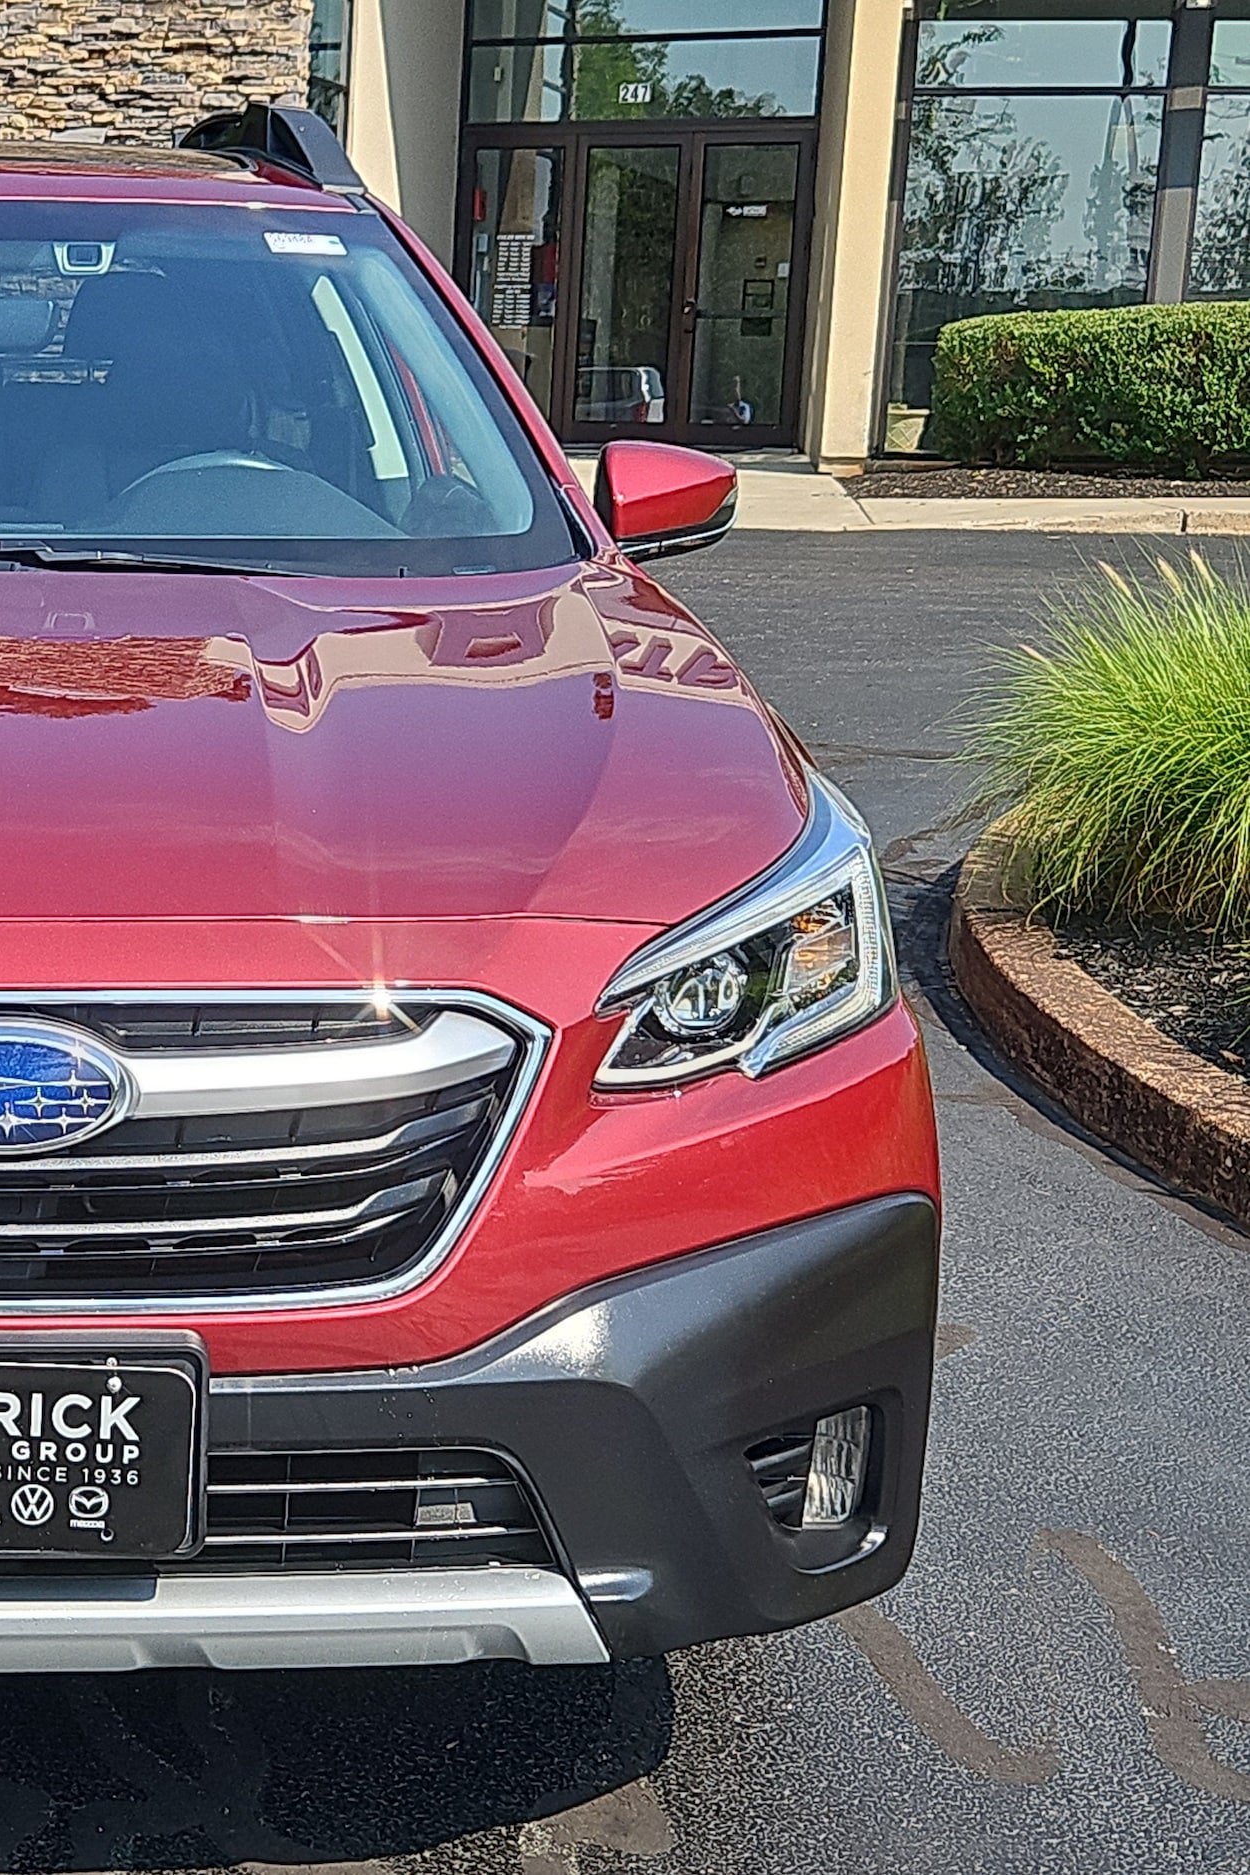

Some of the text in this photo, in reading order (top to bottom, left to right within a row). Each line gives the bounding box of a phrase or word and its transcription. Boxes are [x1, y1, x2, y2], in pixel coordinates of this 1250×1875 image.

[621, 84, 648, 102] 247
[11, 1440, 140, 1465] GROUP
[82, 1467, 139, 1486] 1936
